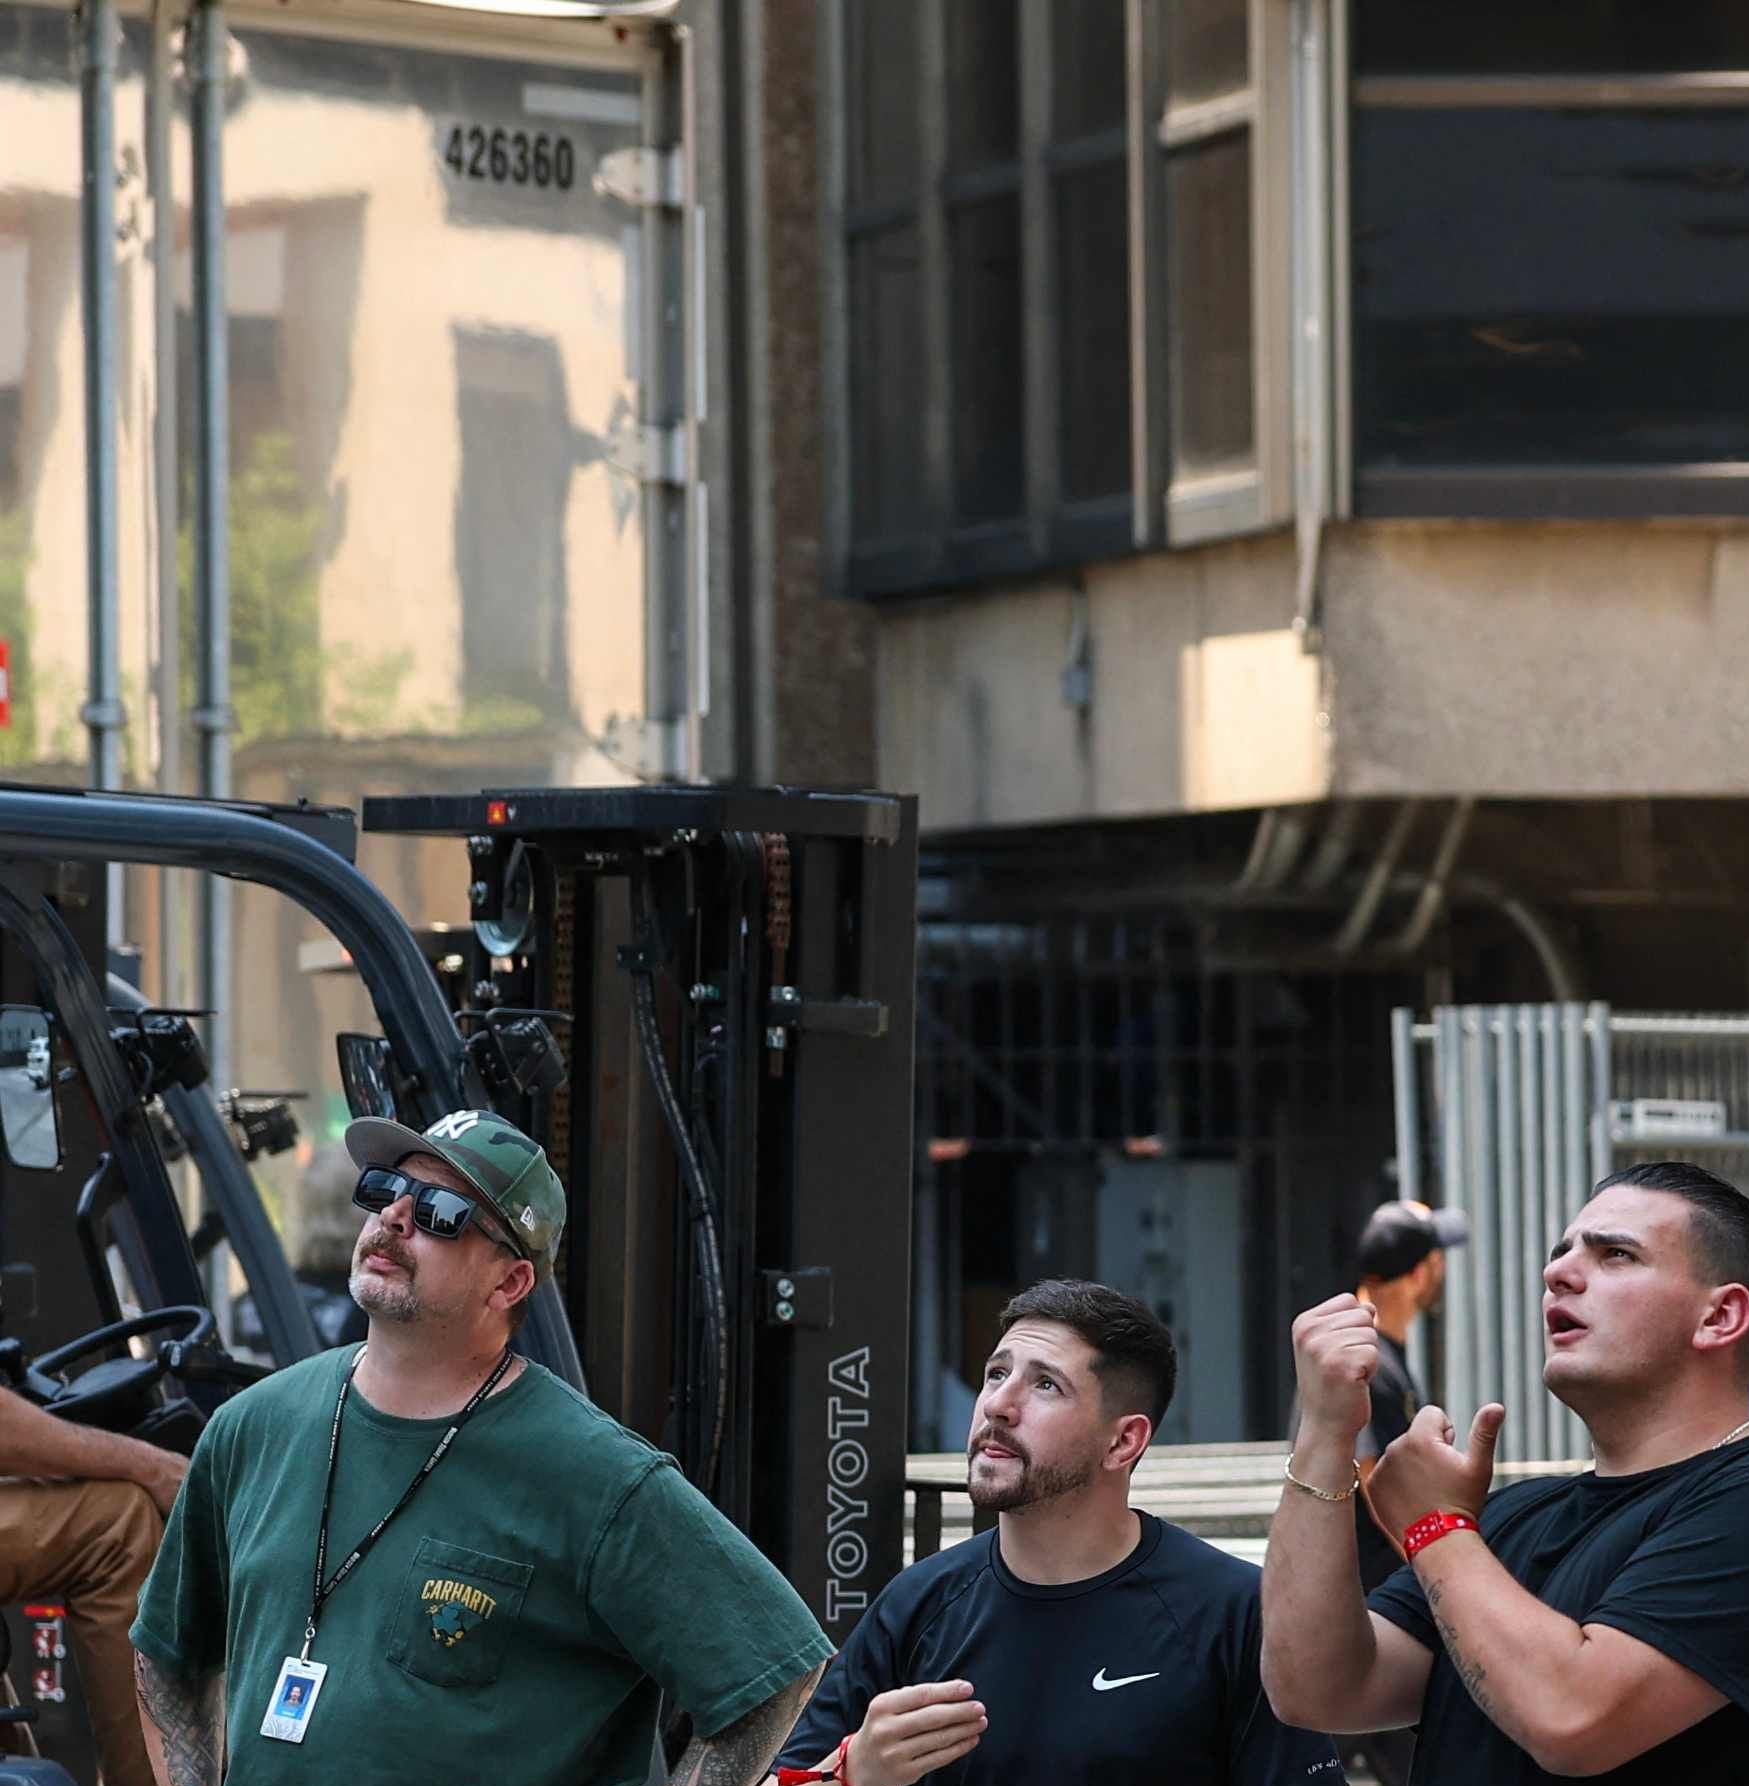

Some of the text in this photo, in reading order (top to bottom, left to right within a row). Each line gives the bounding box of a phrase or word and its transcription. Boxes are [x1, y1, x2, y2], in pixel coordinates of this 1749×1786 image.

[446, 125, 574, 190] 426360
[826, 1346, 870, 1622] TOYOTA
[421, 1580, 497, 1619] CARHARTT
